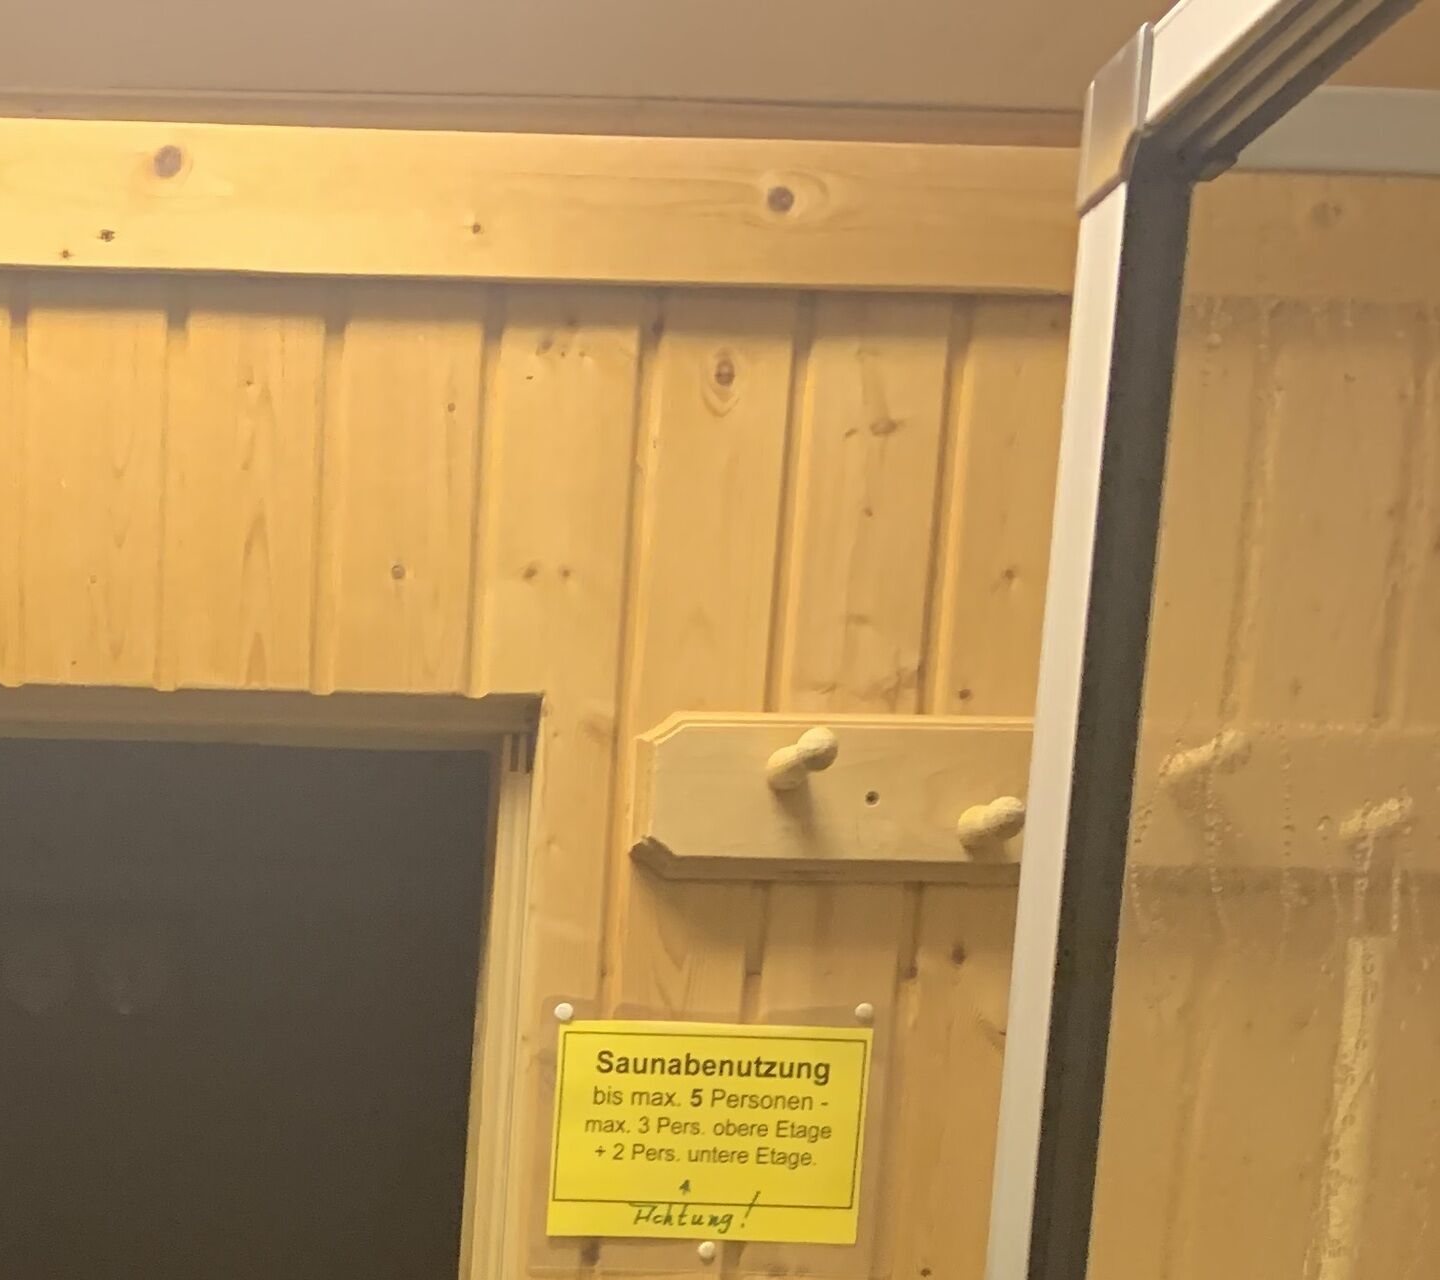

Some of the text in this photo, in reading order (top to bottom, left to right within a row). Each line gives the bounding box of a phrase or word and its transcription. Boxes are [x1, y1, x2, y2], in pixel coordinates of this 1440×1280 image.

[596, 1050, 830, 1086] Saunabenutzung
[593, 1085, 623, 1105] bis
[631, 1090, 681, 1107] max.
[690, 1088, 703, 1108] 5
[710, 1088, 813, 1110] Personen
[585, 1116, 832, 1143] max. 3 Pers. obere Etage
[595, 1142, 817, 1170] + 2 Pers. untere Etage.
